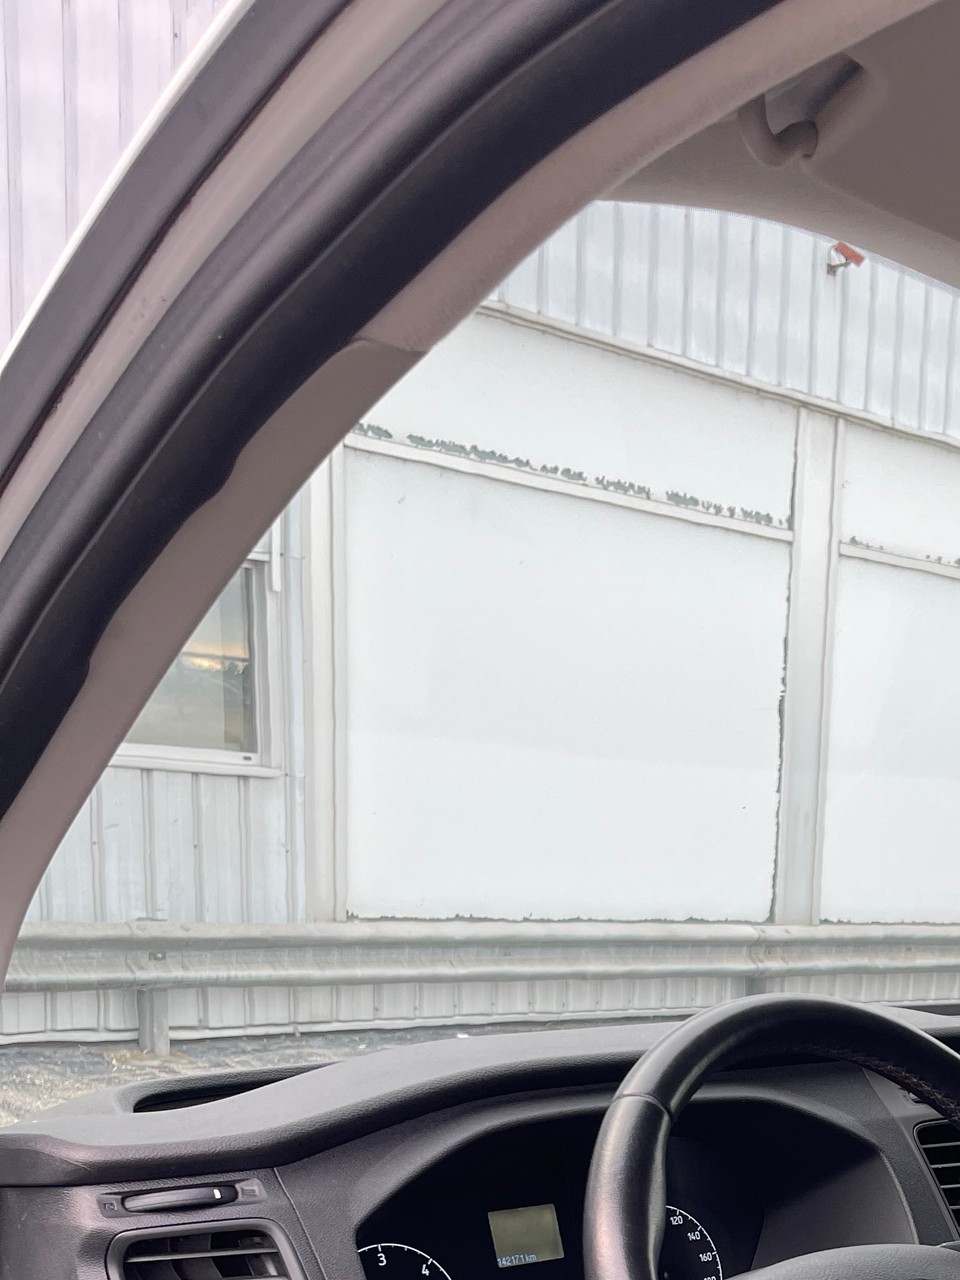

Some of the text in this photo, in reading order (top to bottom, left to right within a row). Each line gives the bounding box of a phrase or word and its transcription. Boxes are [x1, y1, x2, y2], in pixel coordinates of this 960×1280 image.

[670, 1216, 683, 1225] 120
[687, 1231, 701, 1241] 140
[377, 1253, 387, 1266] 3
[497, 1254, 537, 1267] 142171 km
[699, 1252, 712, 1262] 160
[421, 1264, 430, 1276] 4
